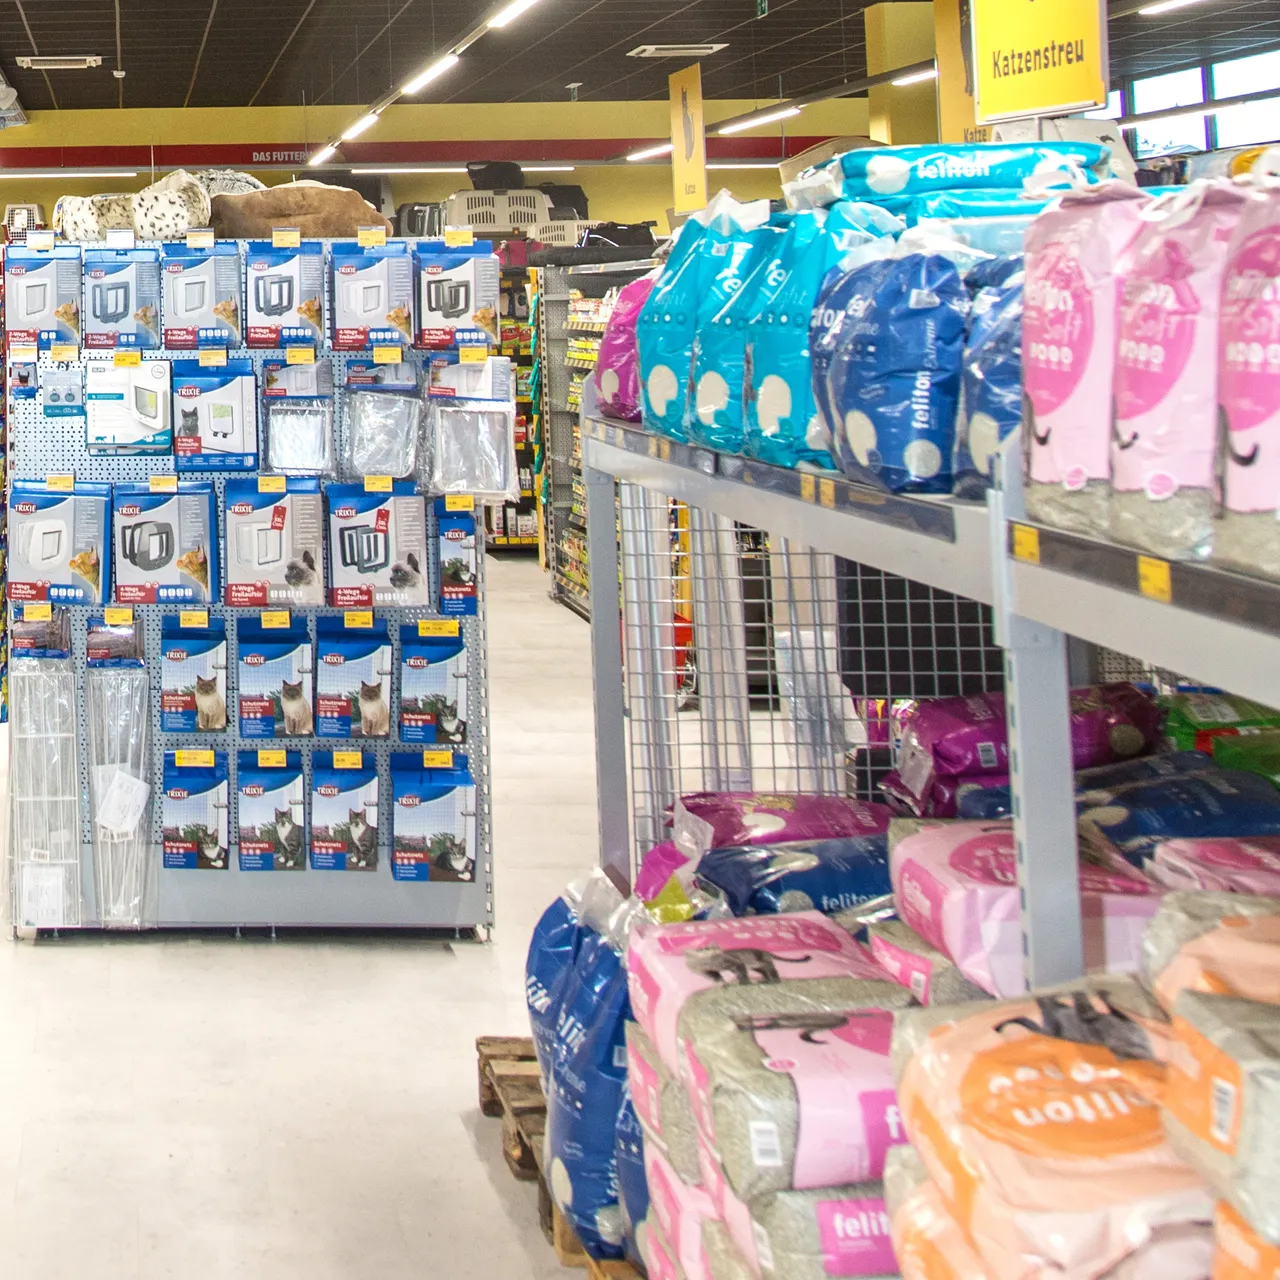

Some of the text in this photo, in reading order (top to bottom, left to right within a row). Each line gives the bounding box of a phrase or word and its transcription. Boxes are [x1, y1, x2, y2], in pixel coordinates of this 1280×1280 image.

[992, 39, 1084, 79] Katzenstreu
[963, 128, 987, 143] Katze
[252, 151, 270, 162] DAS
[177, 387, 201, 397] TRIXIE
[910, 370, 931, 430] feliton
[14, 504, 37, 513] TRIXIE
[118, 506, 141, 515] TRIXIE
[231, 505, 253, 513] TRIXIE
[335, 509, 356, 517] TRIXIE
[444, 531, 466, 539] TRIXIE
[165, 651, 188, 660] TRIXIE
[243, 656, 265, 664] TRIXIE
[322, 656, 345, 664] TRIXIE
[406, 658, 428, 667] TRIXIE
[166, 790, 189, 798] TRIXIE
[242, 787, 264, 795] TRIXIE
[317, 787, 339, 795] TRIXIE
[398, 797, 421, 806] TRIXIE
